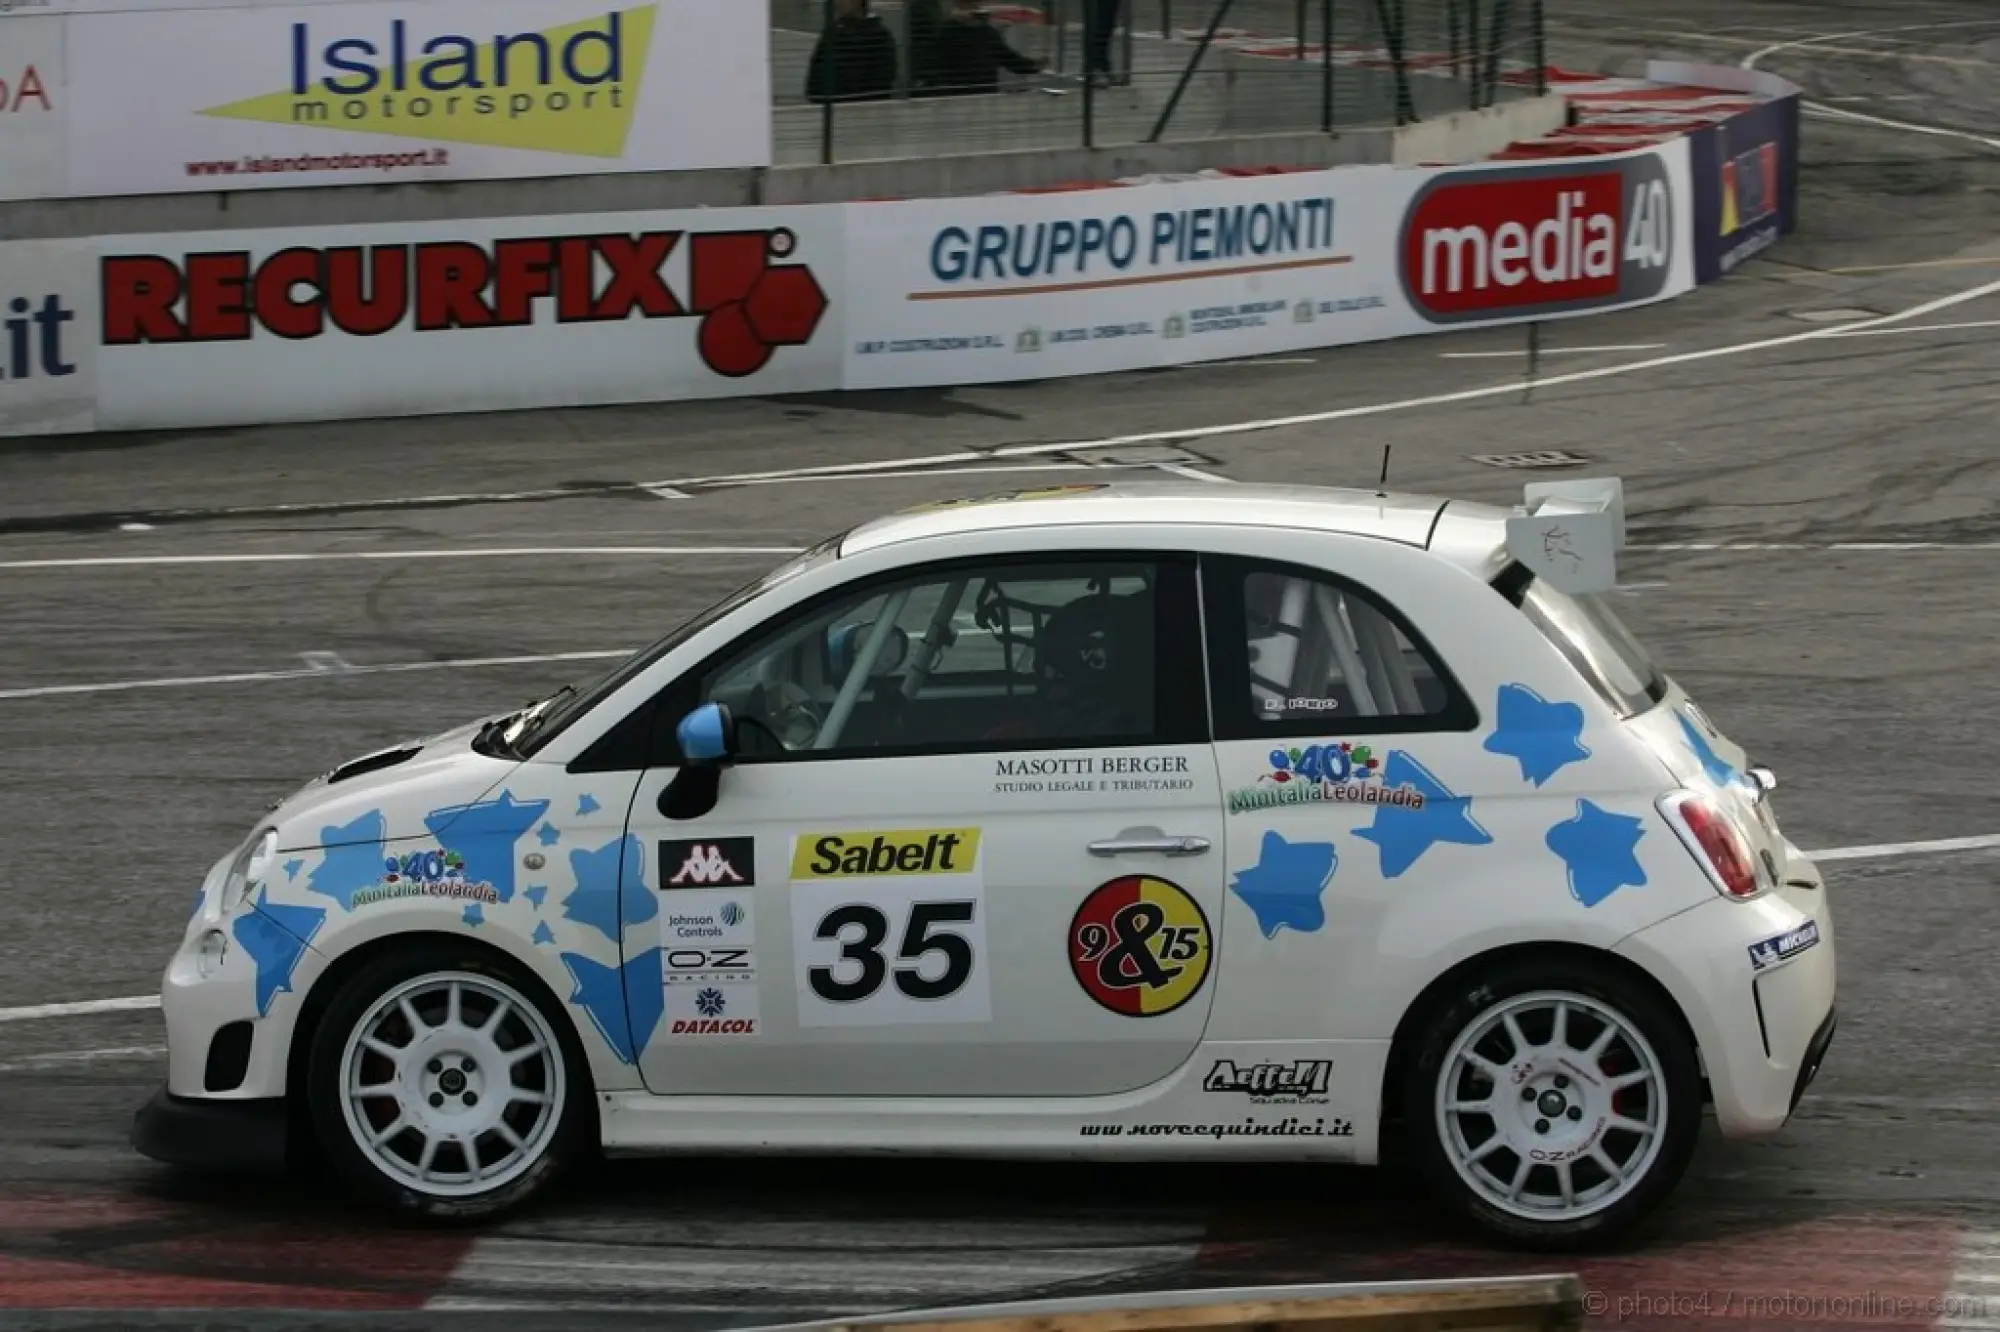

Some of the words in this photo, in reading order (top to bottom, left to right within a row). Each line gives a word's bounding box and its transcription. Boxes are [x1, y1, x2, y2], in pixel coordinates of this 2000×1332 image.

[292, 11, 623, 95] Island
[293, 86, 624, 122] motorsport
[185, 148, 449, 176] www.islandmotorsport.it
[930, 213, 1138, 281] GRUPPO
[1150, 197, 1335, 265] PIEMONTI
[1423, 190, 1617, 295] media
[1624, 179, 1667, 269] 40
[100, 230, 685, 345] RECURFIX
[995, 757, 1094, 776] MASOTTI
[1101, 755, 1189, 774] BERGER
[1295, 743, 1351, 784] 40
[994, 780, 1044, 793] STUDIO
[1048, 779, 1095, 792] LEGALE
[1100, 779, 1109, 791] E
[1112, 778, 1194, 791] TRIBUTARIO
[1229, 780, 1425, 815] MinitaliaLeolandia
[402, 851, 445, 883] 40
[809, 832, 961, 876] Sabelt
[668, 914, 714, 927] Johnson
[677, 926, 724, 938] Controls
[806, 899, 977, 1006] 35
[671, 1018, 755, 1034] DATACOL
